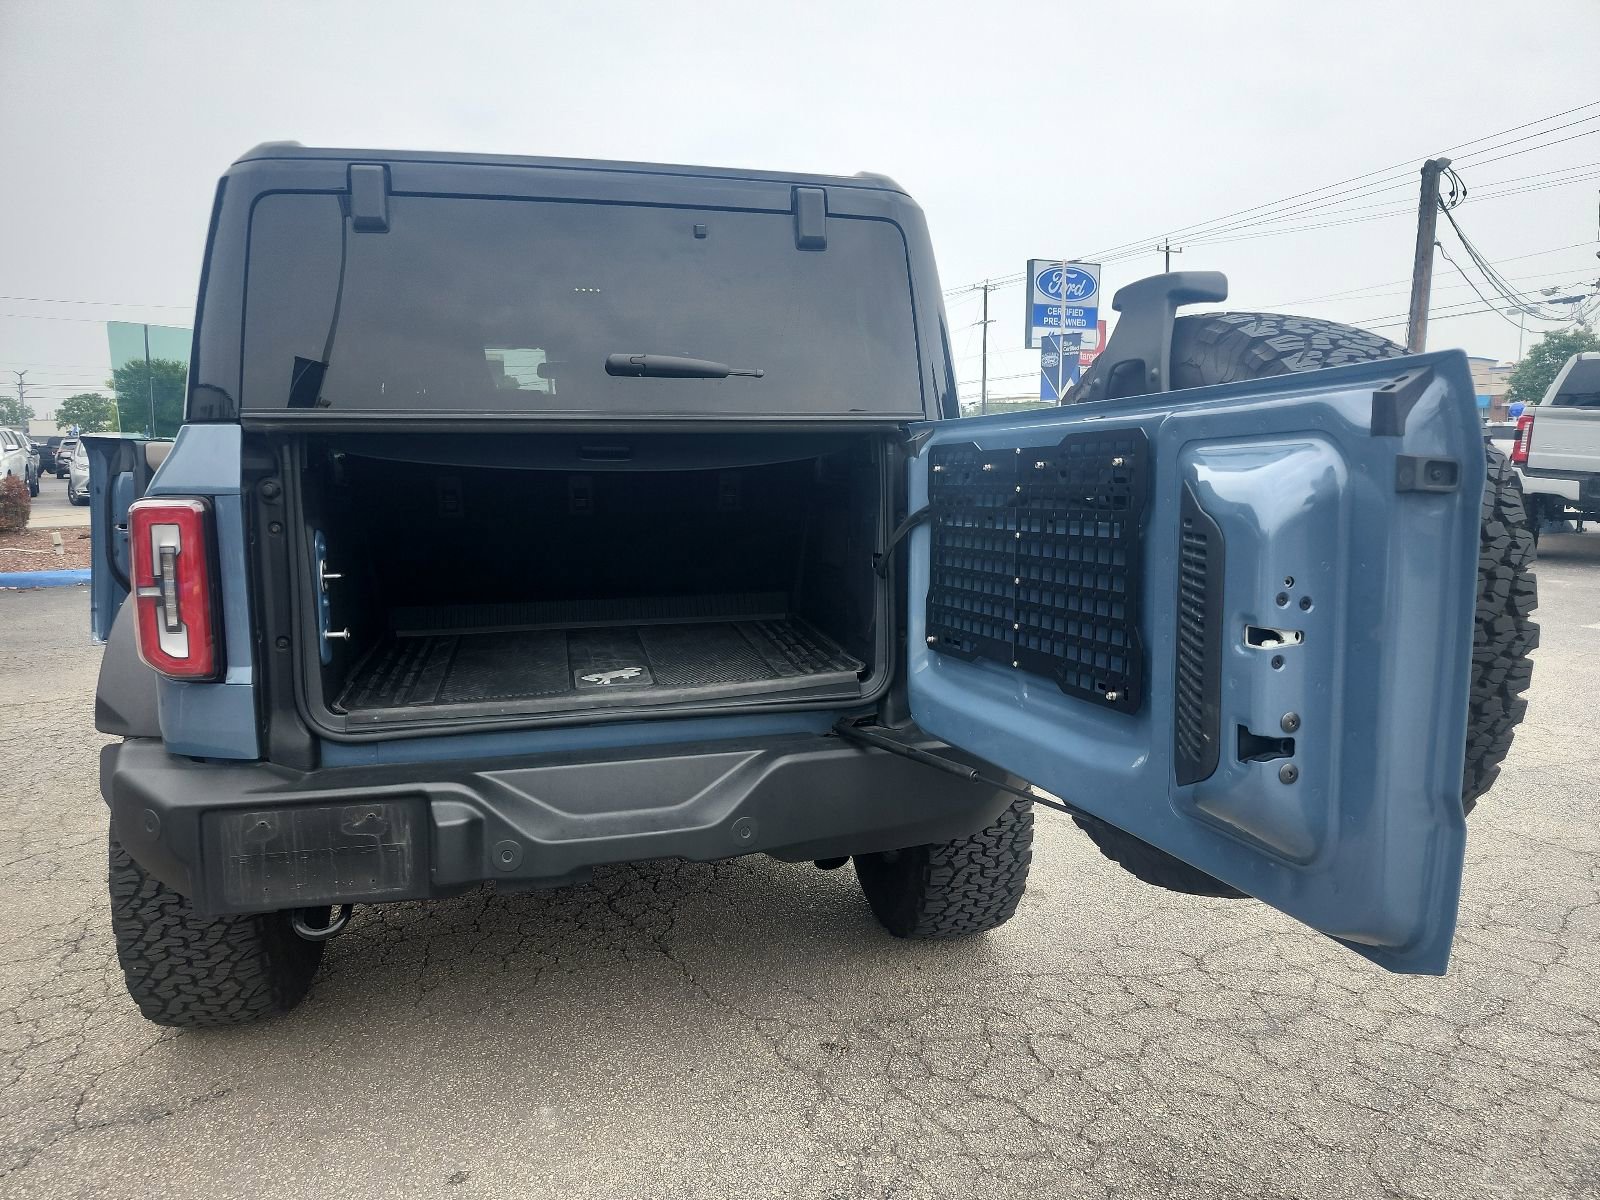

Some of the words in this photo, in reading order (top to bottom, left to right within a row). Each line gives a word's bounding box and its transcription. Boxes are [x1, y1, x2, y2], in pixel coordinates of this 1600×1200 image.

[1048, 271, 1087, 297] Frd
[1047, 307, 1084, 317] CERIFIED
[1043, 317, 1087, 327] PRE-WNED
